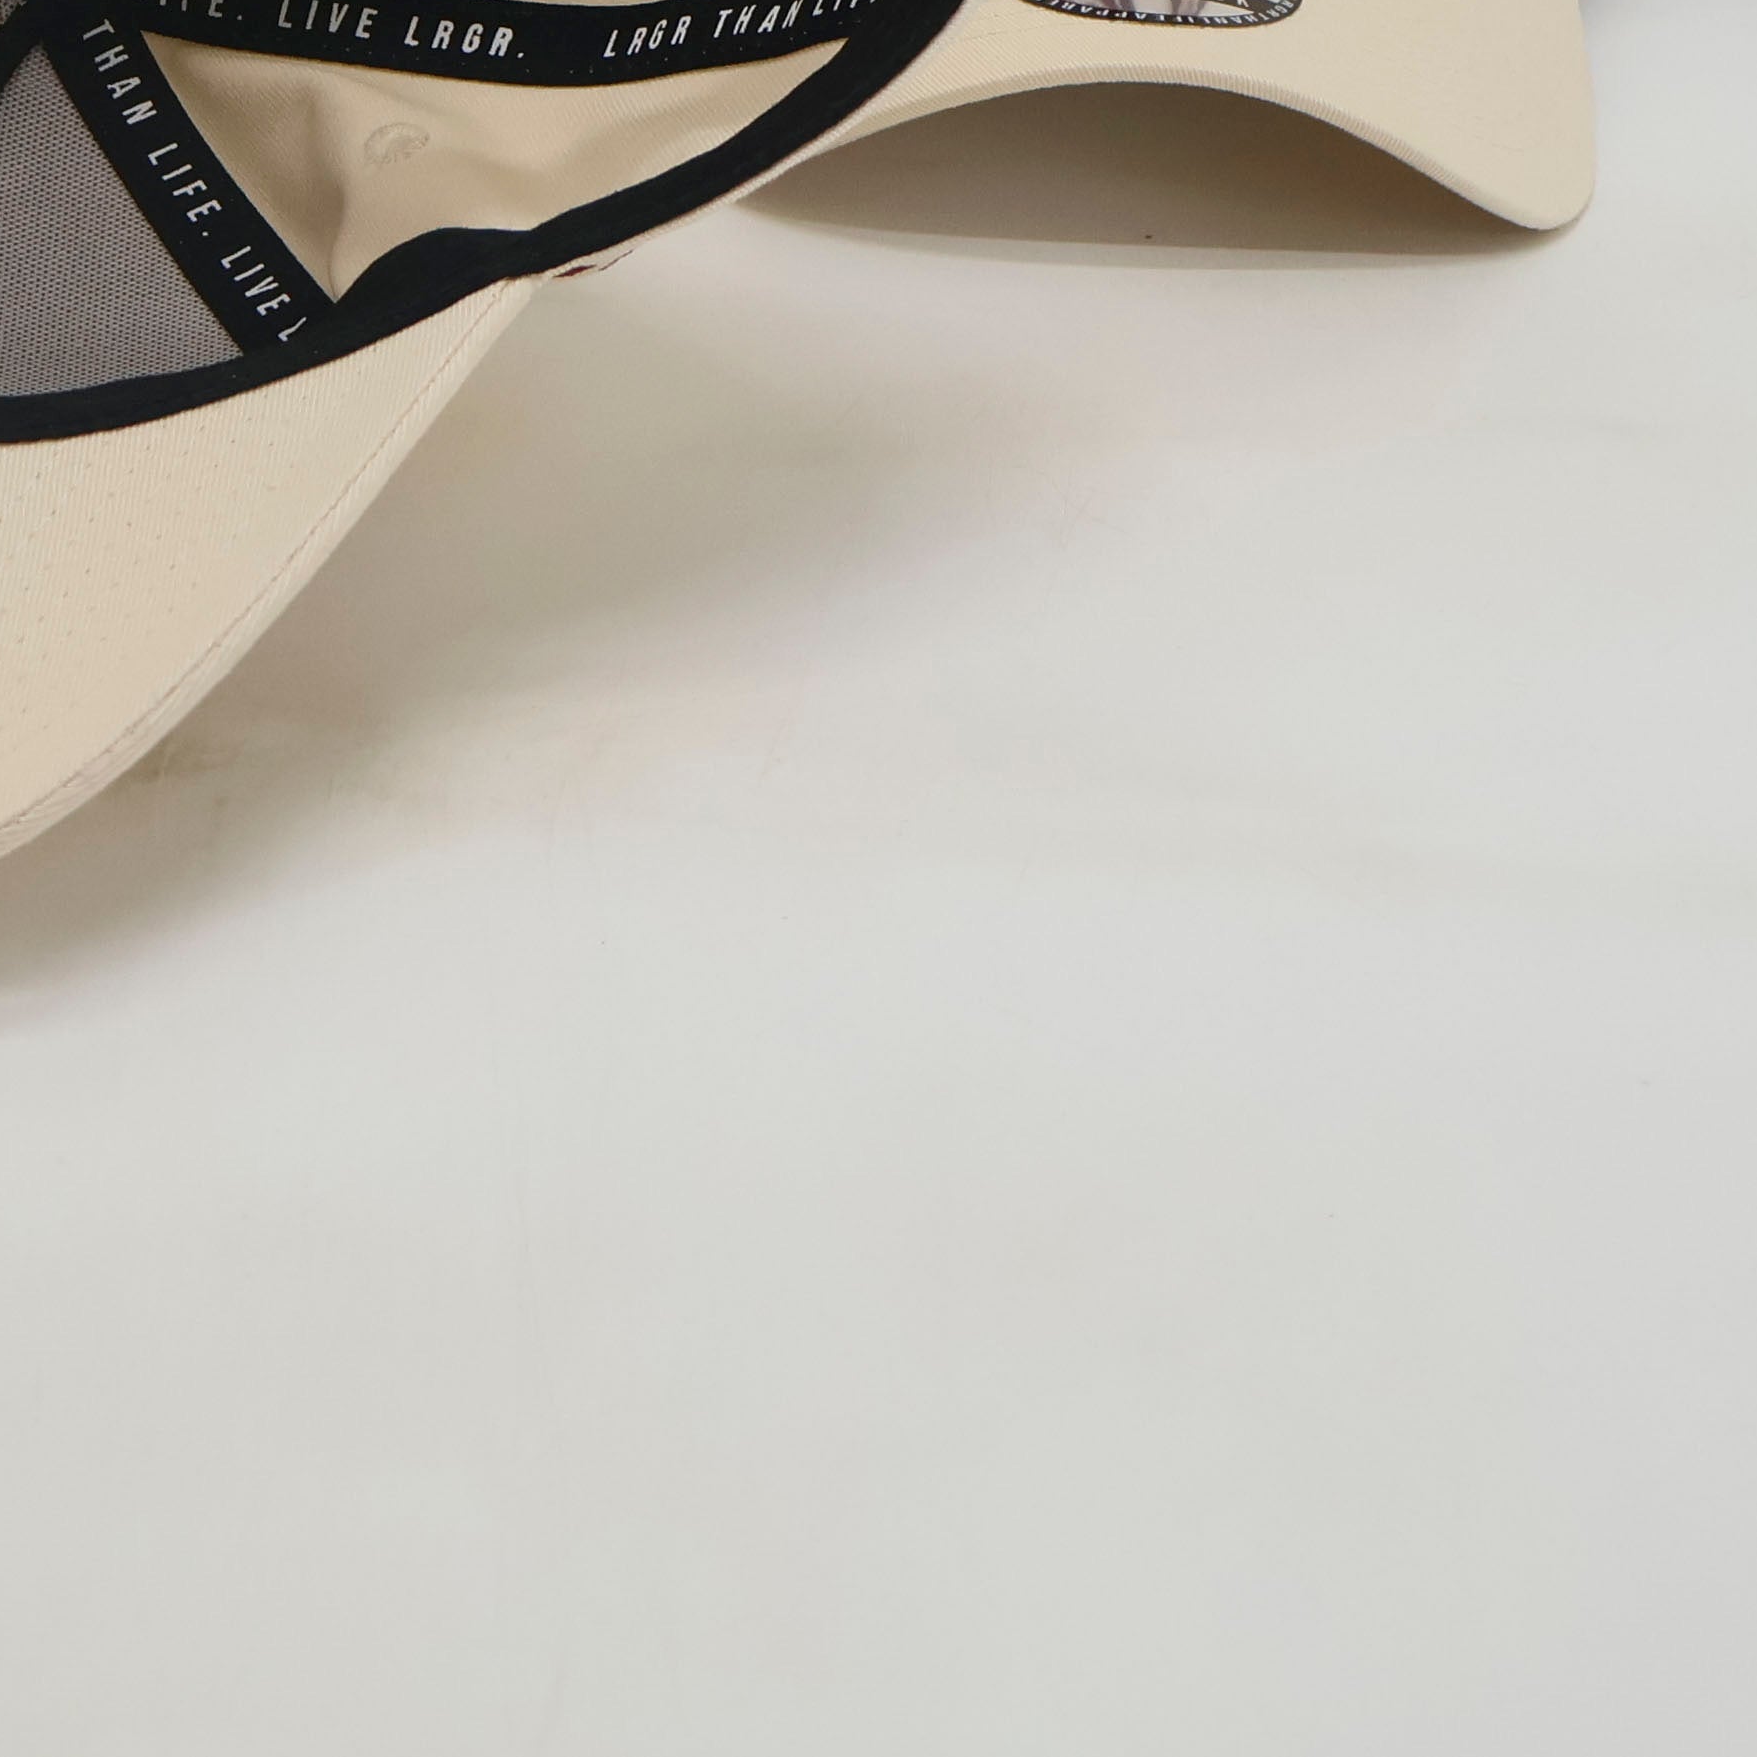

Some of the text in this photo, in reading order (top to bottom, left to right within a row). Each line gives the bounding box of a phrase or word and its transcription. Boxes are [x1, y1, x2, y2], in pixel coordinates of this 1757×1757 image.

[602, 15, 692, 58] LRGR
[82, 18, 157, 126] THAN
[220, 245, 291, 317] LIVE
